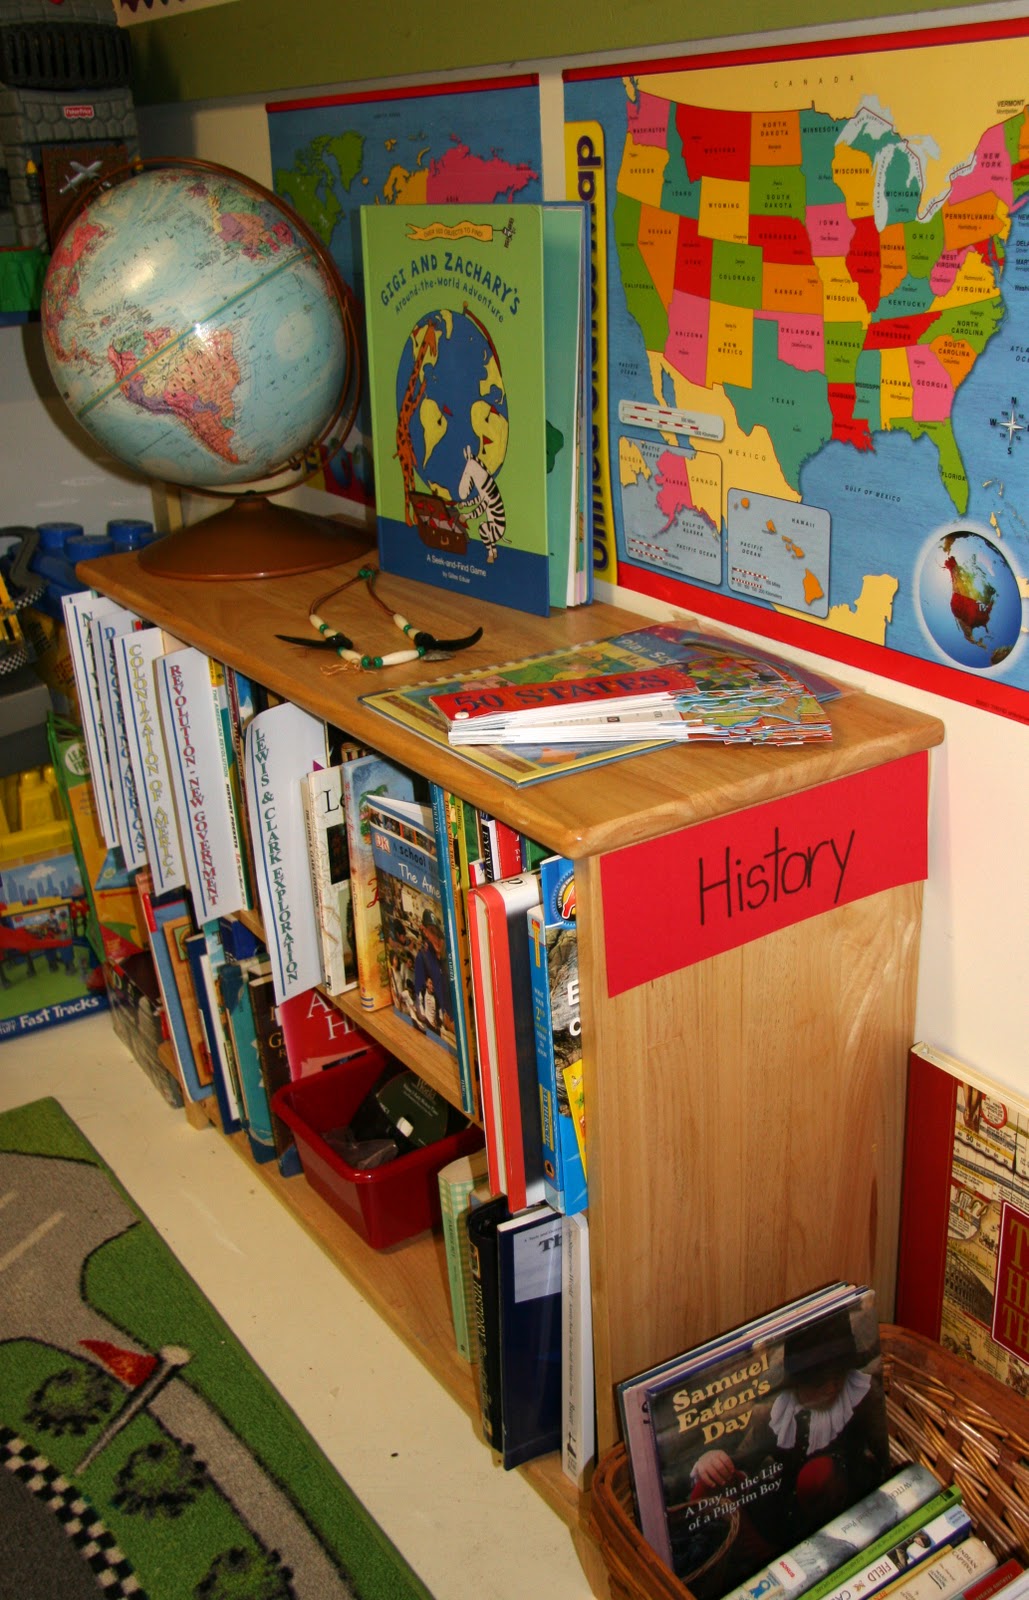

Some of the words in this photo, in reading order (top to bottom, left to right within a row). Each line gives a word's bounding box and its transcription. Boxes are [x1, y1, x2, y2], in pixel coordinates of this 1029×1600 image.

[773, 75, 854, 88] CANADA
[997, 99, 1025, 108] VERMONT
[632, 127, 666, 135] WASHINGTON
[762, 121, 787, 129] NORTH
[802, 126, 839, 134] MINNESOTA
[885, 190, 919, 198] MICHIGAN
[444, 228, 464, 237] OBJECTS
[380, 268, 408, 307] GIGI
[411, 253, 438, 278] AND
[444, 251, 521, 316] ZACHARY'S
[719, 274, 756, 282] COLORADO
[774, 288, 803, 296] KANSAS
[956, 286, 991, 294] VIRGINIA
[462, 282, 504, 323] Adventure
[826, 295, 858, 303] MISSOURI
[888, 299, 926, 308] KENTUCKY
[781, 327, 820, 337] OKLAHOMA
[951, 328, 984, 337] CAROLINA
[827, 339, 860, 349] ARKANSAS
[944, 341, 965, 349] SOUTH
[718, 347, 743, 356] MEXICO
[938, 348, 970, 357] CAROLINA
[881, 378, 911, 388] ALABAMA
[916, 379, 948, 390] GEORGIA
[771, 397, 795, 406] TEXAS
[1011, 396, 1017, 405] N
[989, 418, 997, 426] W
[728, 449, 767, 461] MEXICO
[1007, 447, 1012, 455] S
[620, 454, 642, 464] RUSSIA
[665, 477, 687, 487] ALASKA
[691, 476, 718, 487] CANADA
[941, 471, 966, 481] FLORIDA
[845, 485, 862, 493] GULF
[875, 492, 901, 503] MEXICO
[682, 520, 695, 529] GULF
[792, 518, 815, 528] HAWAII
[683, 528, 704, 537] ALASKA
[676, 543, 697, 553] PACIFIC
[699, 549, 717, 559] OCEAN
[740, 541, 763, 552] PACIFIC
[742, 549, 761, 558] OCEAN
[426, 554, 431, 562] A
[431, 556, 470, 572] Seek-and-Find
[469, 565, 487, 577] Game
[442, 571, 448, 579] by
[453, 693, 506, 713] 50
[514, 673, 670, 705] STATES
[128, 645, 161, 777] COLONIZATION
[170, 665, 196, 768] REVOLUTION
[215, 703, 223, 738] AMERICAN
[254, 727, 270, 788] LEWIS
[149, 778, 163, 802] OF
[188, 777, 205, 809] NEW
[261, 791, 274, 805] &
[225, 783, 234, 815] HISTORY
[230, 816, 238, 849] POCKETS
[154, 806, 176, 877] AMERICA
[264, 807, 282, 865] CLARK
[375, 832, 391, 856] DK
[192, 811, 218, 906] GOVERNMENT
[399, 844, 426, 866] school
[398, 862, 418, 884] The
[698, 826, 855, 926] History
[272, 867, 299, 985] EXPLORATION
[19, 1007, 51, 1029] Fast
[52, 996, 100, 1019] Tracks
[965, 1134, 974, 1144] 50
[472, 1281, 488, 1345] HISTORY
[672, 1352, 770, 1414] Samuel
[676, 1377, 772, 1435] Eaton's
[702, 1408, 753, 1446] Day
[684, 1505, 696, 1519] A
[697, 1491, 723, 1513] Day
[725, 1485, 738, 1498] in
[739, 1474, 760, 1492] the
[761, 1460, 785, 1480] Life
[888, 1481, 914, 1501] WITCH
[688, 1516, 702, 1533] of
[703, 1514, 712, 1526] a
[712, 1490, 758, 1521] Pilgrim
[759, 1476, 783, 1498] Boy
[840, 1519, 858, 1535] Pond
[951, 1550, 974, 1575] CAPTIVE
[957, 1547, 979, 1570] INDIAN
[778, 1559, 796, 1579] BONUS
[867, 1561, 892, 1582] FIELD
